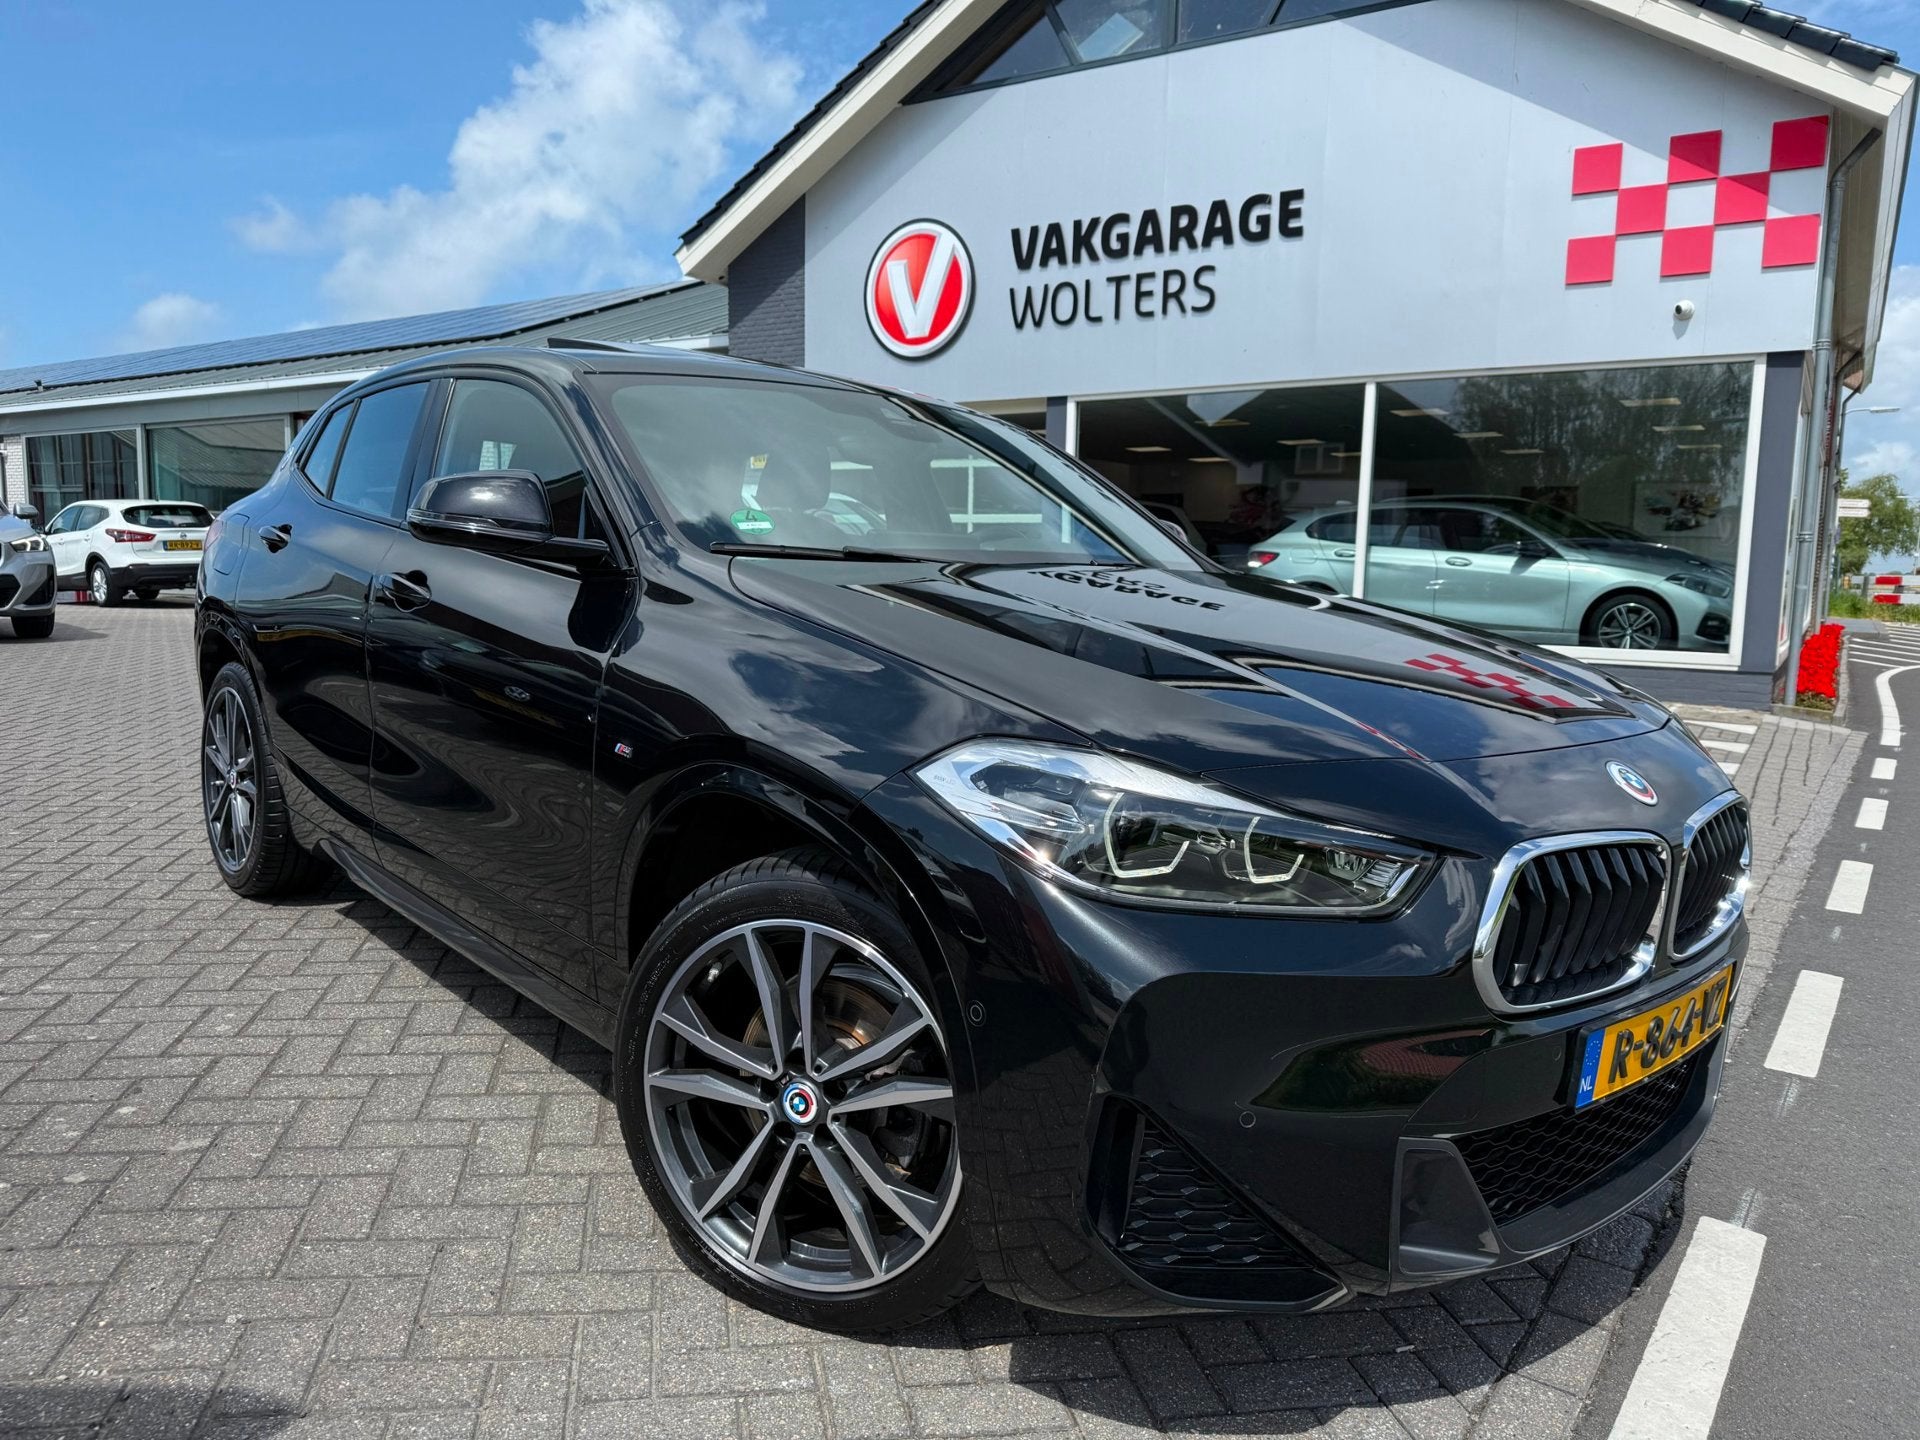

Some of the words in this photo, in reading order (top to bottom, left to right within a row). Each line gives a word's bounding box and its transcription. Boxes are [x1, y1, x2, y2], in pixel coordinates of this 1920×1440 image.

[1010, 188, 1305, 270] VAKGARAGE
[1009, 265, 1216, 330] WOLTERS
[1579, 1075, 1593, 1093] NL
